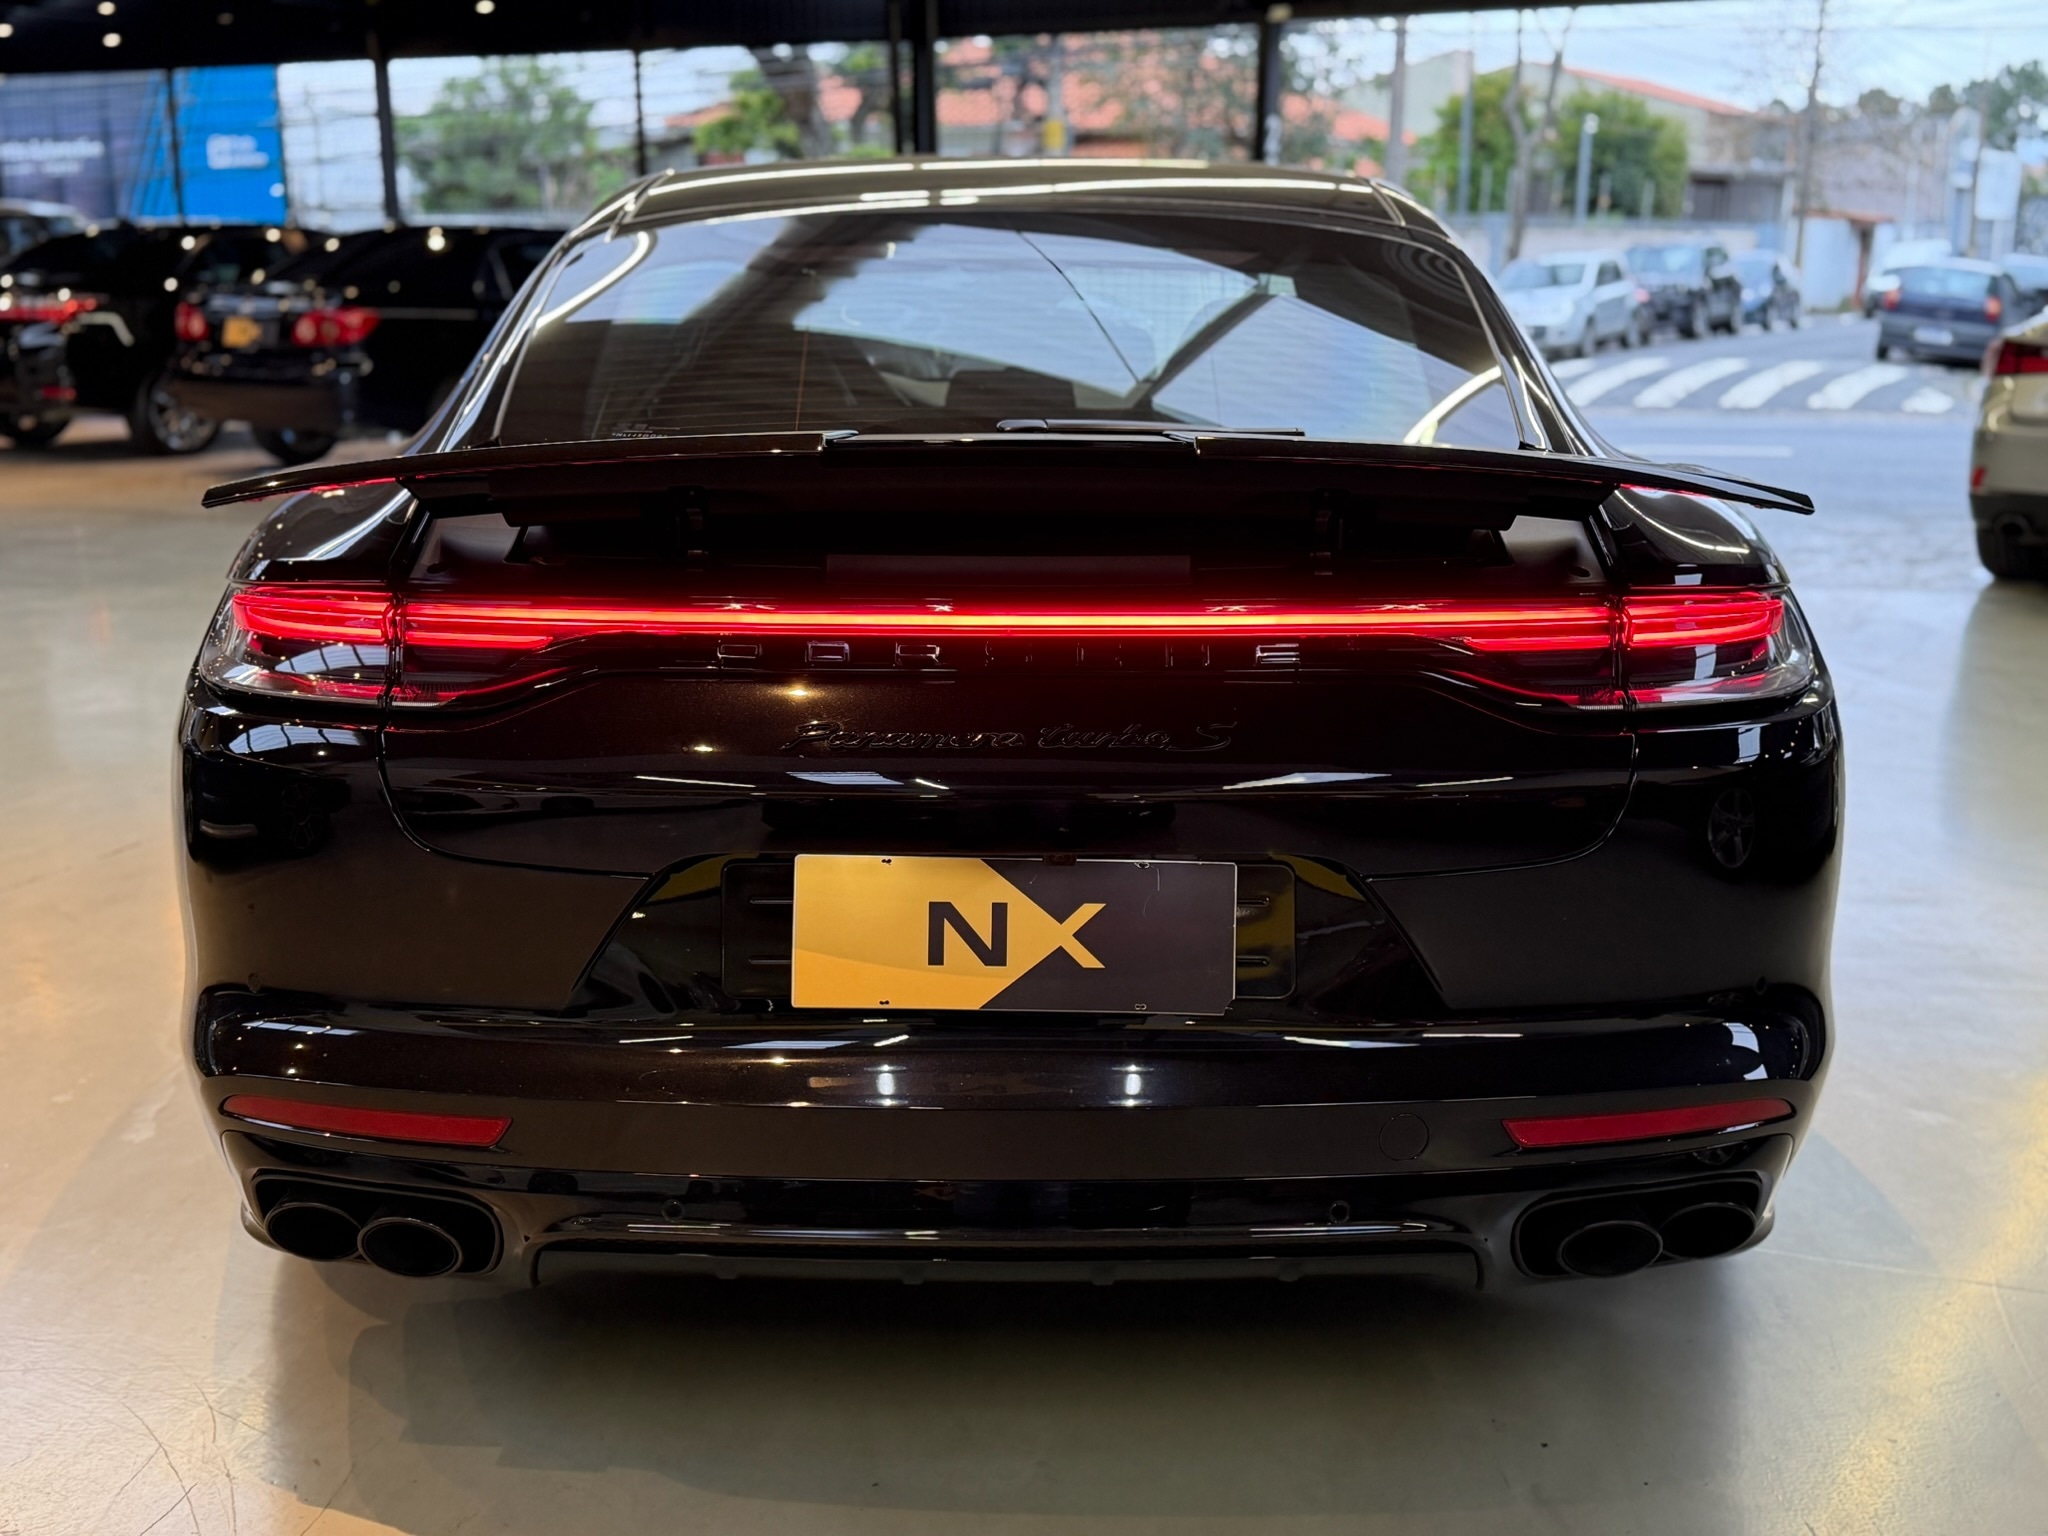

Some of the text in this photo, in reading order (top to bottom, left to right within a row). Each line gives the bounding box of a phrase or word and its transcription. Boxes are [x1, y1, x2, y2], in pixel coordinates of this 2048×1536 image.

[780, 720, 1026, 750] Panamera
[1170, 722, 1238, 752] S
[927, 901, 1106, 969] NX
